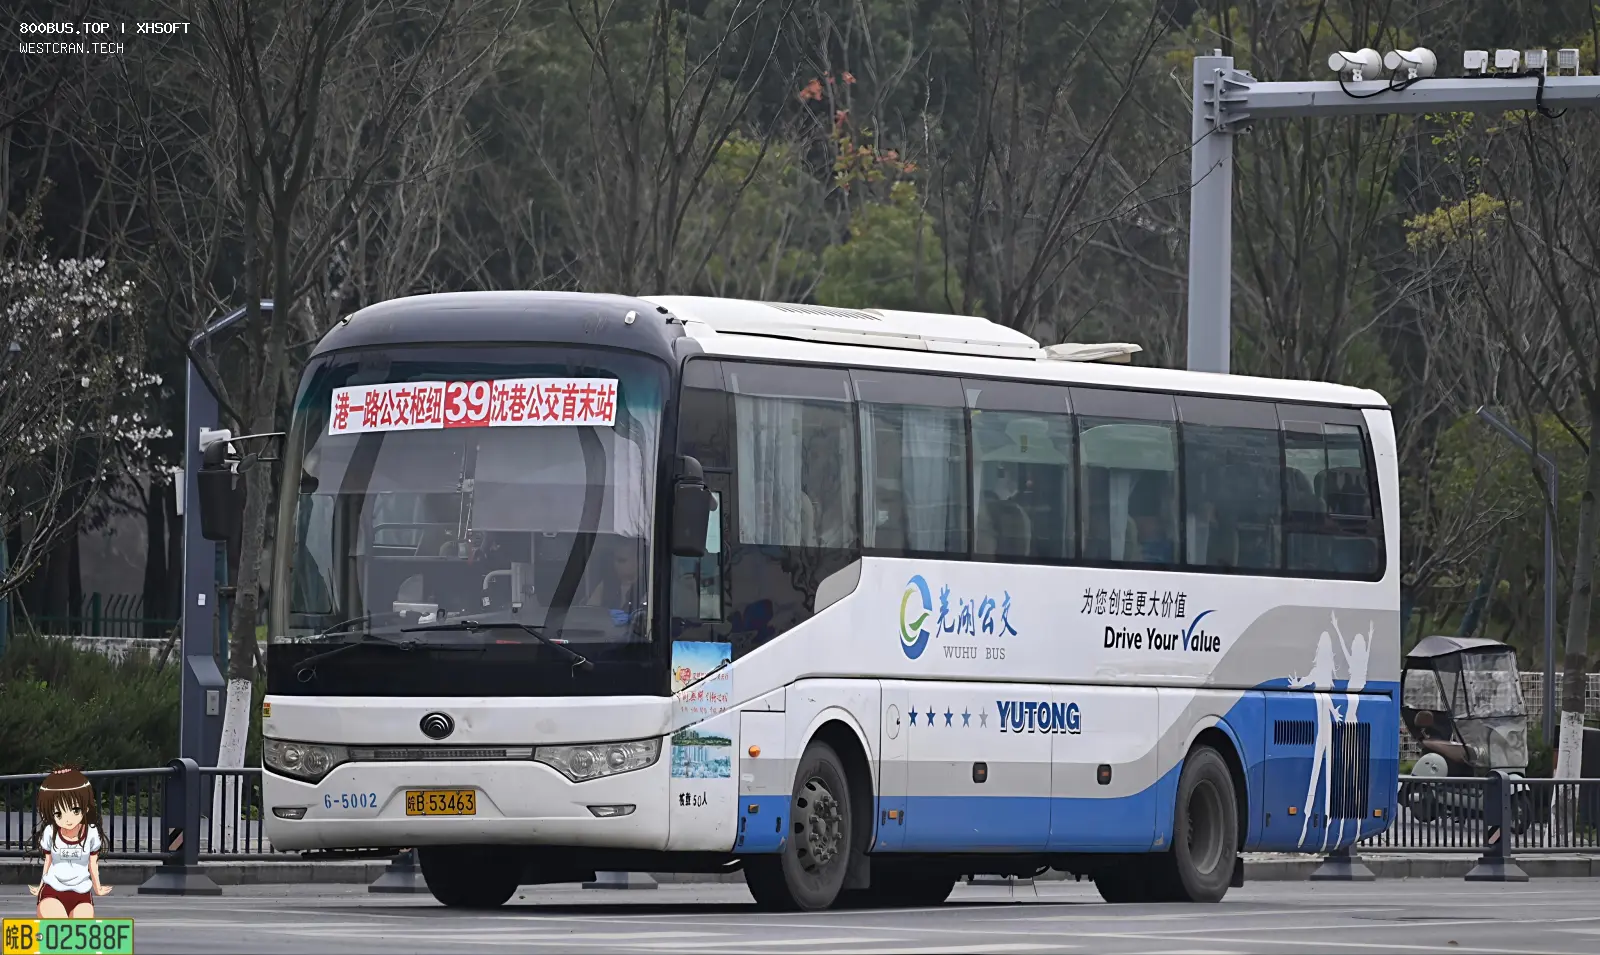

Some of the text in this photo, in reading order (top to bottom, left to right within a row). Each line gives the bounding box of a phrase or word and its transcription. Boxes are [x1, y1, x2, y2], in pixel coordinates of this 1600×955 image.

[333, 381, 616, 430] 港一路公交枢纽 39 沈巷公交首末站
[935, 583, 1018, 639] 芜湖公交
[1080, 587, 1188, 618] 为您创造更大价值
[1103, 609, 1221, 653] Drive Your Value
[943, 646, 1006, 660] WUHU BUS
[996, 700, 1082, 735] YUTONG
